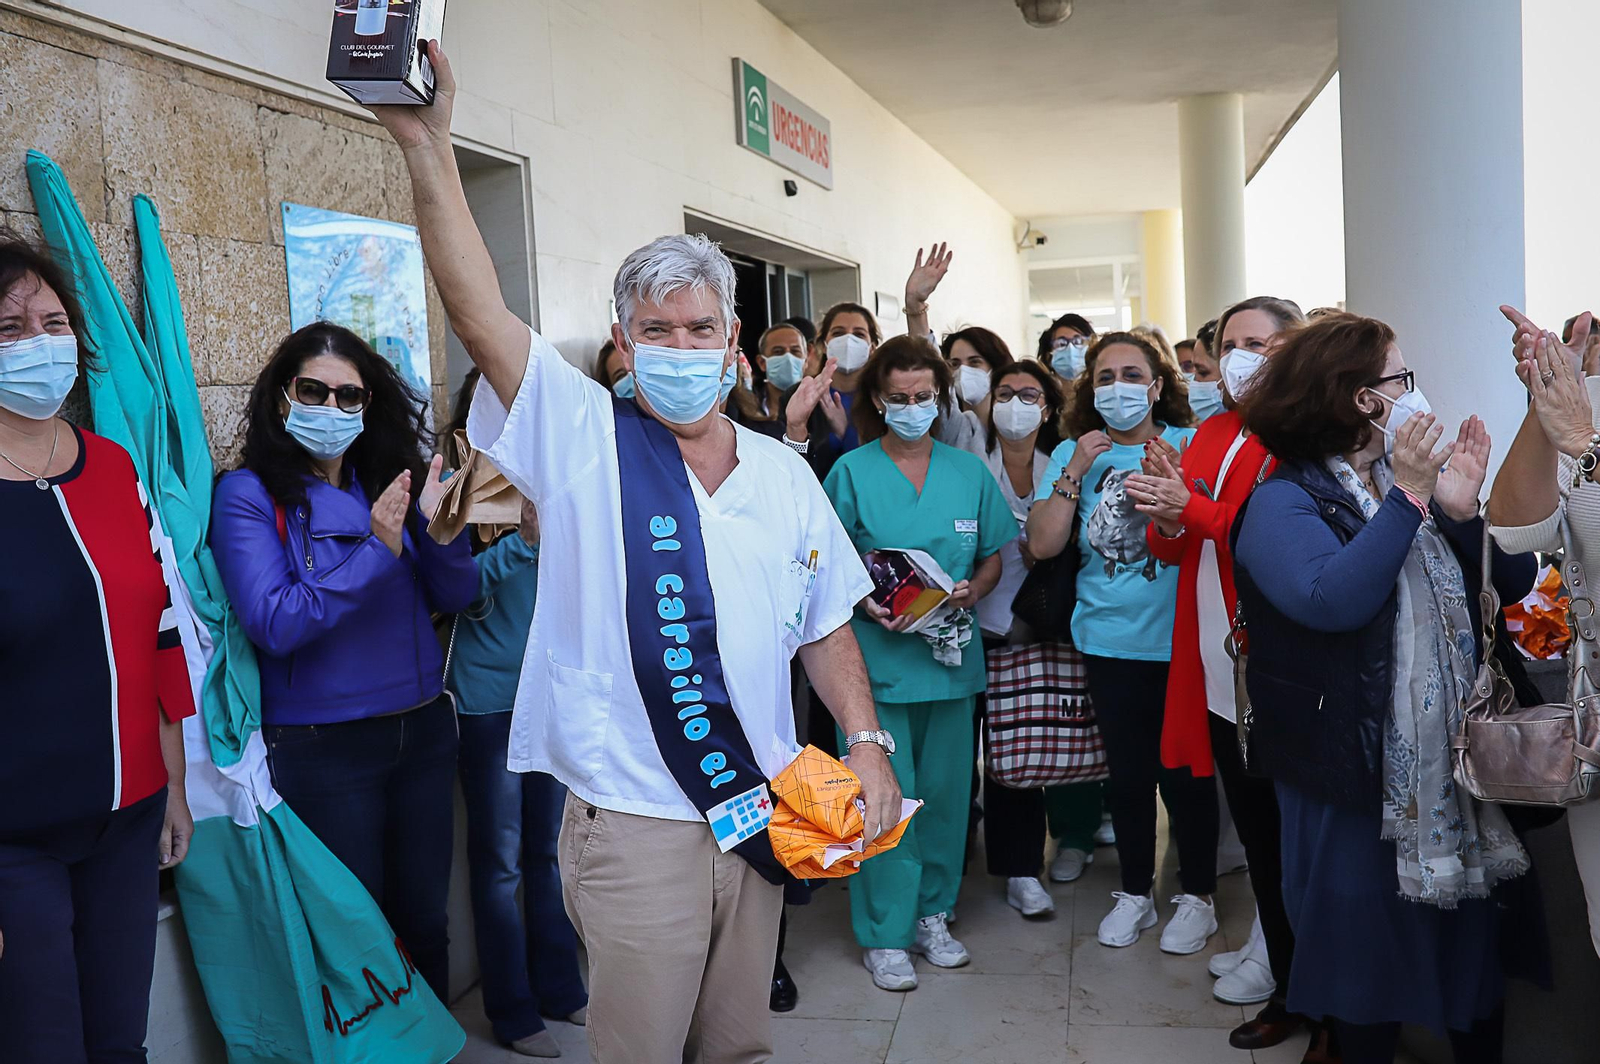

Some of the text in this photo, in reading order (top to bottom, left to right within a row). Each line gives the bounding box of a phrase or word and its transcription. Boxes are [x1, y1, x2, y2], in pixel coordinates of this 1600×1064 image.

[772, 100, 829, 169] URGENCIAS
[649, 515, 737, 789] al caraillo el
